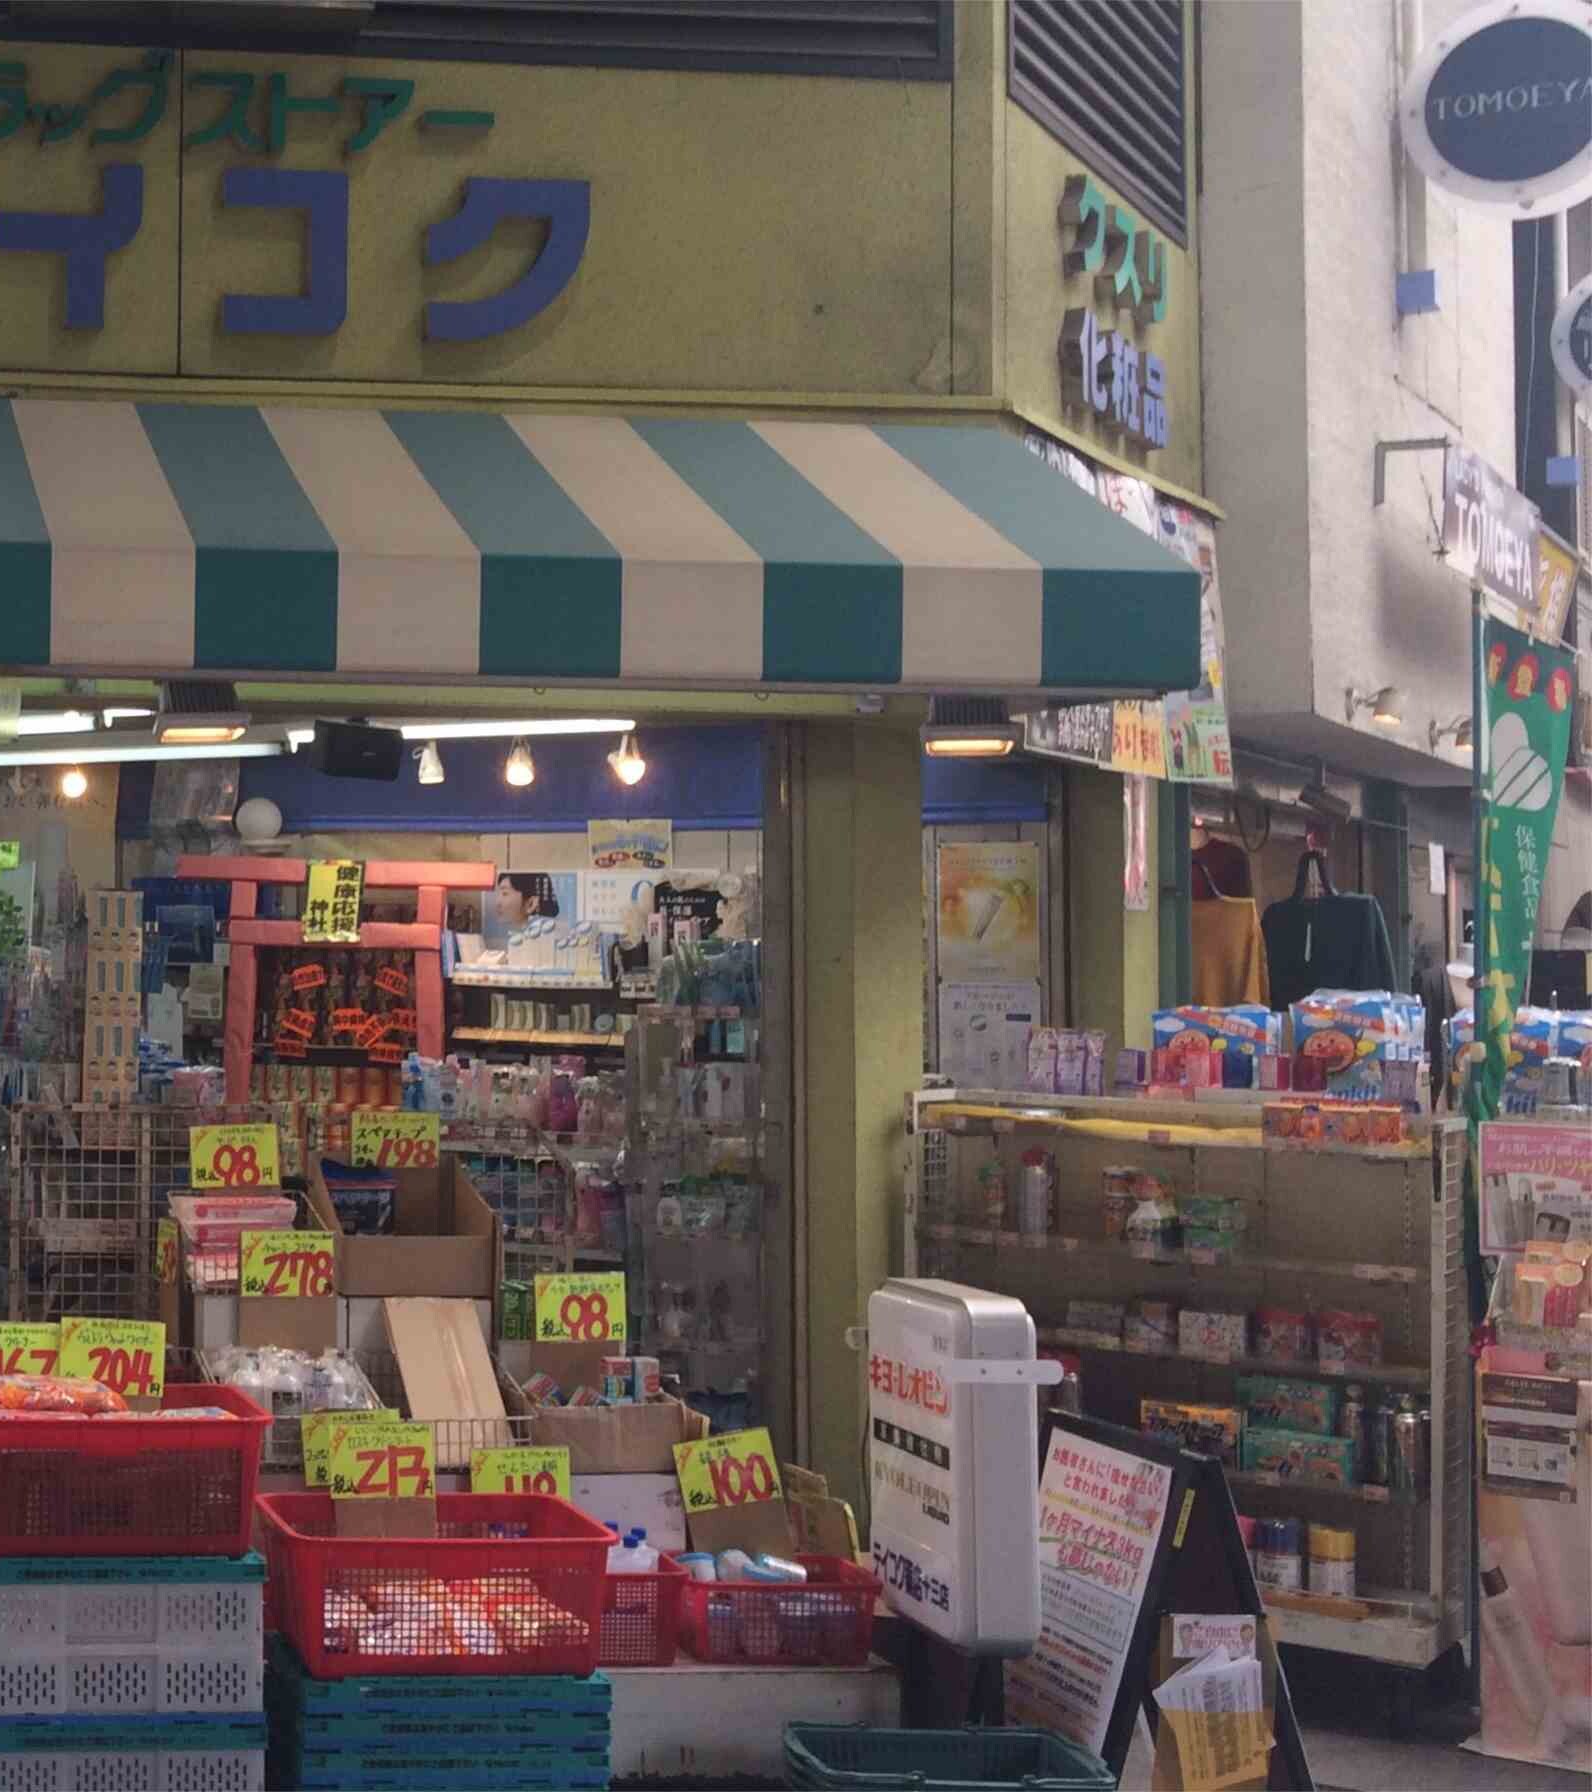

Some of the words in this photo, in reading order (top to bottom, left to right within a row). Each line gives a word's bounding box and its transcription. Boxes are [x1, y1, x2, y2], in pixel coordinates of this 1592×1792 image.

[1066, 174, 1168, 324] クスリ
[1068, 308, 1168, 449] 化粧品
[309, 899, 329, 933] 神社
[332, 865, 360, 933] 健康応援
[212, 1144, 262, 1187] 98
[377, 1137, 437, 1168] 198
[263, 1250, 335, 1297] 278
[559, 1292, 610, 1341] 98
[87, 1346, 154, 1395] 204
[707, 1451, 774, 1506] 100
